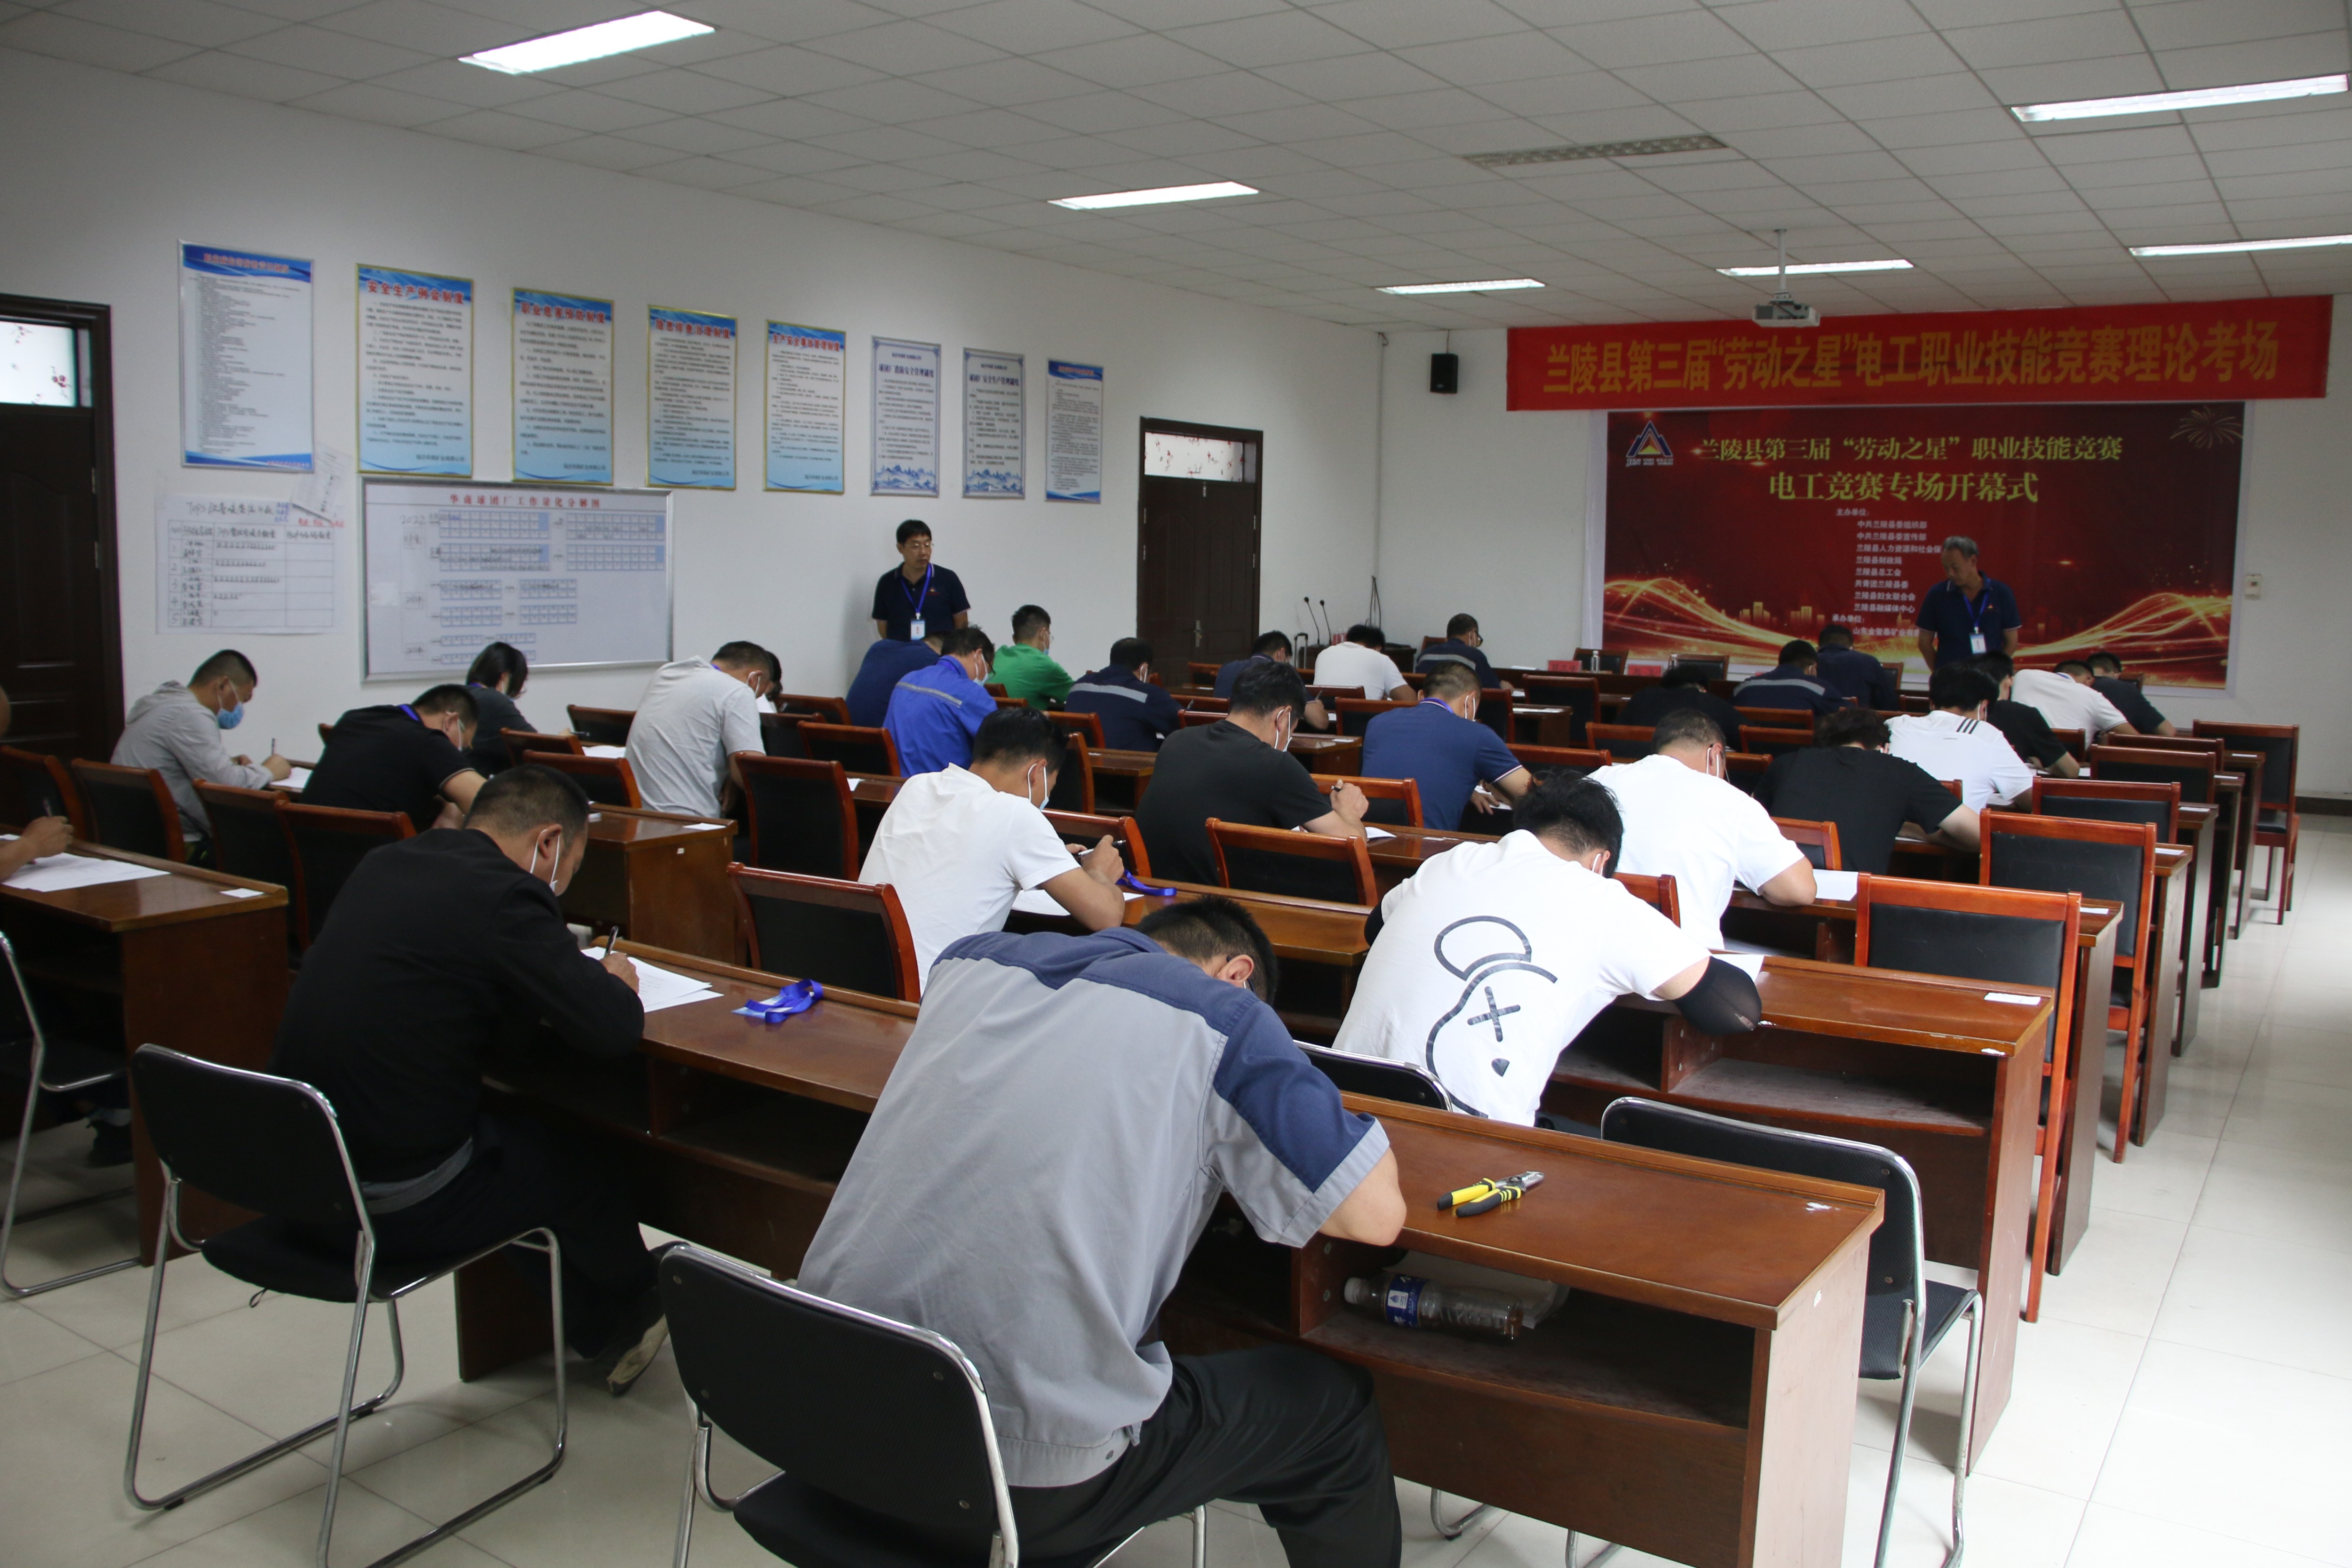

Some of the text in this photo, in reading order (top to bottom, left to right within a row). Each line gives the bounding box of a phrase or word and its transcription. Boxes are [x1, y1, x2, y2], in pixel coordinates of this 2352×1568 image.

[367, 280, 463, 304] 安全生产例会制度
[521, 302, 605, 323] 职业危害预防制度
[656, 319, 730, 339] 隐患排查治理制度
[773, 333, 840, 351] 生产安全事故管理制度
[1770, 472, 2038, 502] 电工竞赛专场开幕式
[1858, 520, 1927, 529] 中共兰陵县委组织部
[1857, 532, 1926, 541] 中共兰陵县委宣传部
[1856, 556, 1902, 565] 兰陵县财政局
[1855, 568, 1901, 576] 兰陵县总工会
[1855, 580, 1908, 589] 共青团兰陵县委
[1854, 591, 1915, 601] 兰陵县妇女联合会
[1854, 603, 1915, 613] 兰陵县融媒体中心
